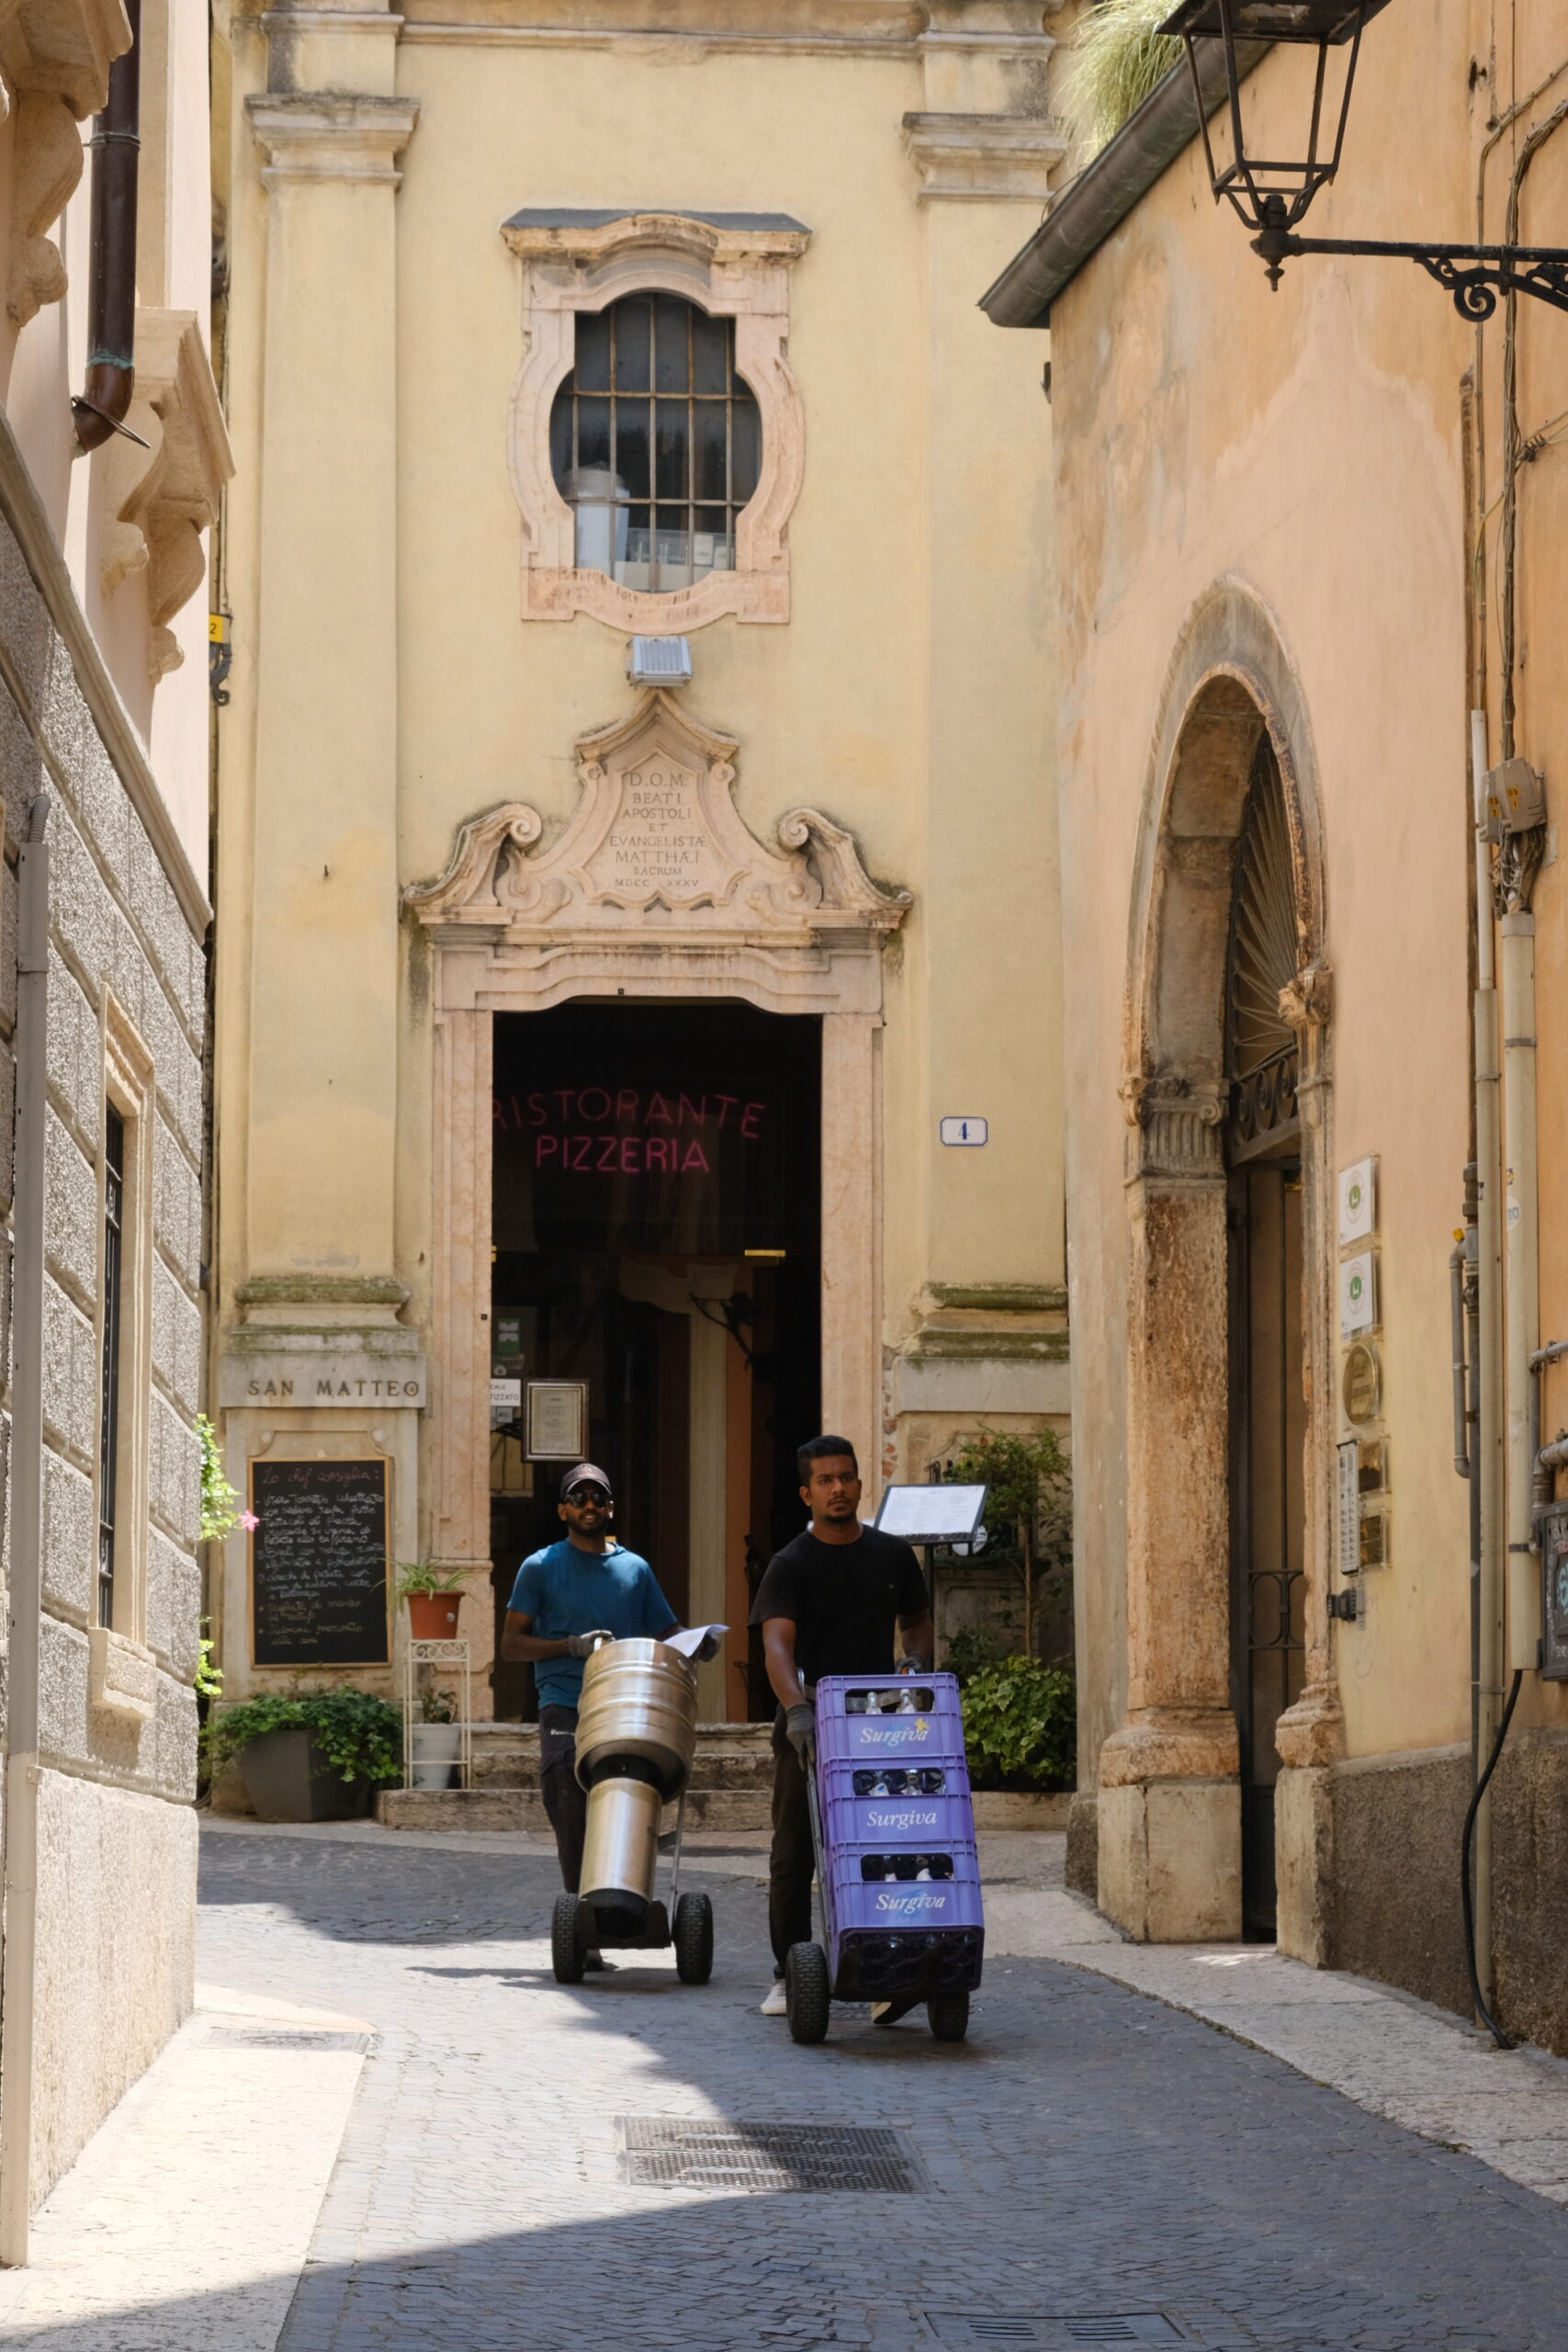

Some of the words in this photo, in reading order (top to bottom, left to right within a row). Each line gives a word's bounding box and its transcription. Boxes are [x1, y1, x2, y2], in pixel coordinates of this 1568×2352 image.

[209, 622, 218, 635] 2
[633, 792, 681, 805] BEATI
[622, 808, 692, 820] APOSTOLI
[649, 822, 669, 832] ET
[633, 866, 682, 876] SACRUM
[615, 878, 650, 888] MDCC
[536, 1135, 710, 1174] PIZZERIA
[248, 1379, 295, 1397] SAN
[316, 1379, 421, 1397] MATTEO
[860, 1726, 929, 1747] Surgiva
[866, 1809, 938, 1830] Surgiva
[875, 1893, 947, 1915] Surgiva
